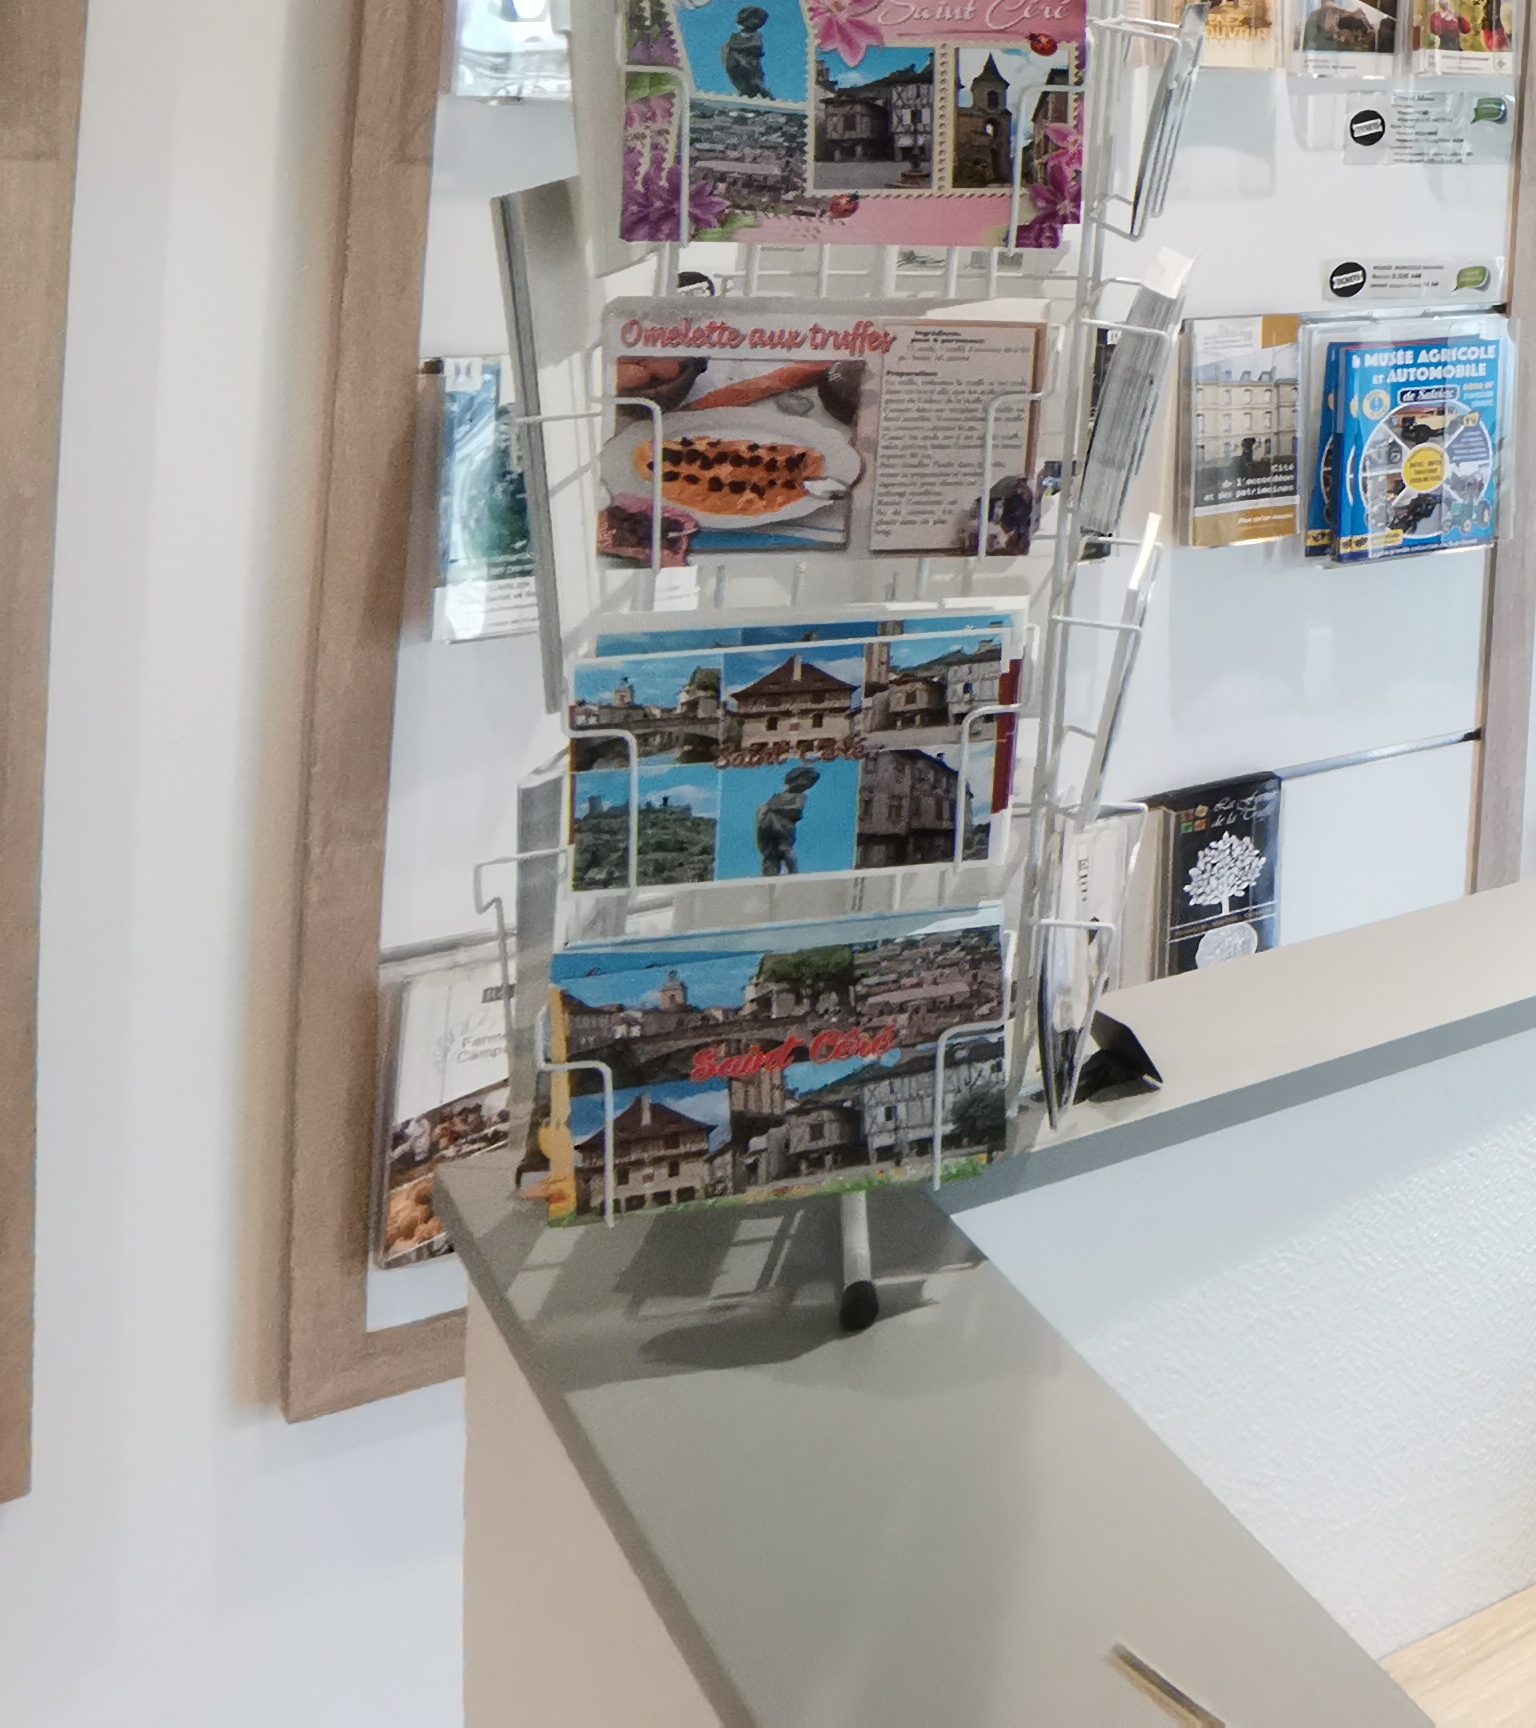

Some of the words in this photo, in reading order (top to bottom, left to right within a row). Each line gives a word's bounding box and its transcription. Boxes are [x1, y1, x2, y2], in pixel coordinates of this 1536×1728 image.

[620, 317, 747, 350] Omelette
[748, 327, 807, 352] aux
[808, 320, 898, 357] truffes
[1364, 349, 1414, 368] MUSÉE
[1417, 345, 1497, 364] AGRICOLE
[1386, 363, 1487, 384] AUTOMOBILE
[690, 1034, 804, 1083] Saint
[809, 1024, 899, 1064] Céré
